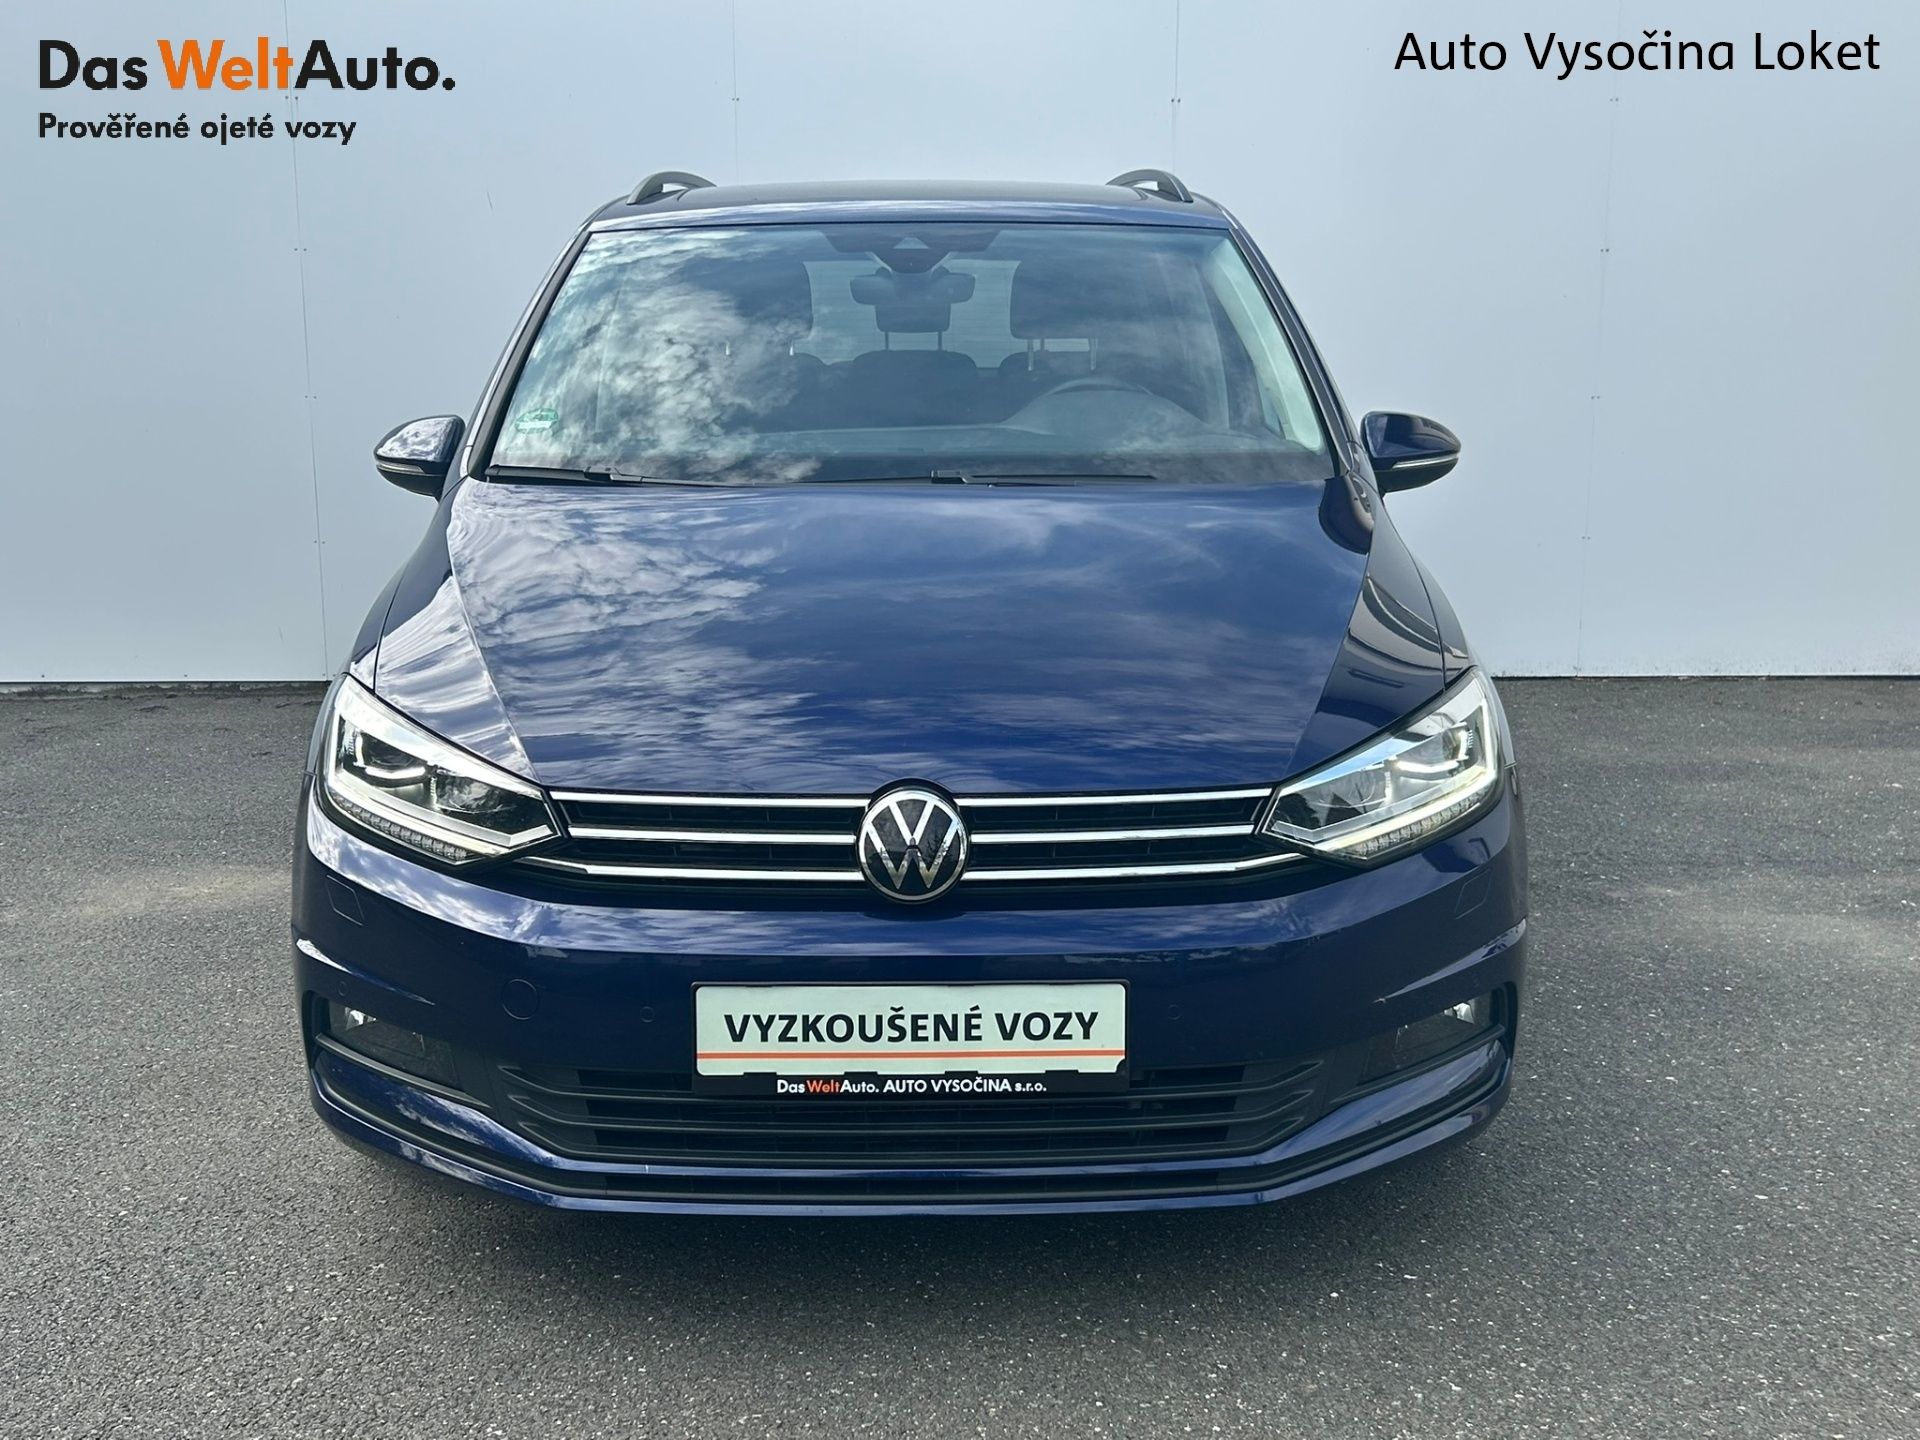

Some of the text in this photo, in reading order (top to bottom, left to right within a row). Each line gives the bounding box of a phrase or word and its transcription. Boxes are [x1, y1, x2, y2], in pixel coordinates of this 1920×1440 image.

[724, 1005, 1099, 1043] VYZKOUŠENÉ VOZY
[883, 1080, 927, 1093] AUTO
[931, 1076, 1012, 1092] VYSOČINA
[1015, 1083, 1048, 1092] s.r.o.
